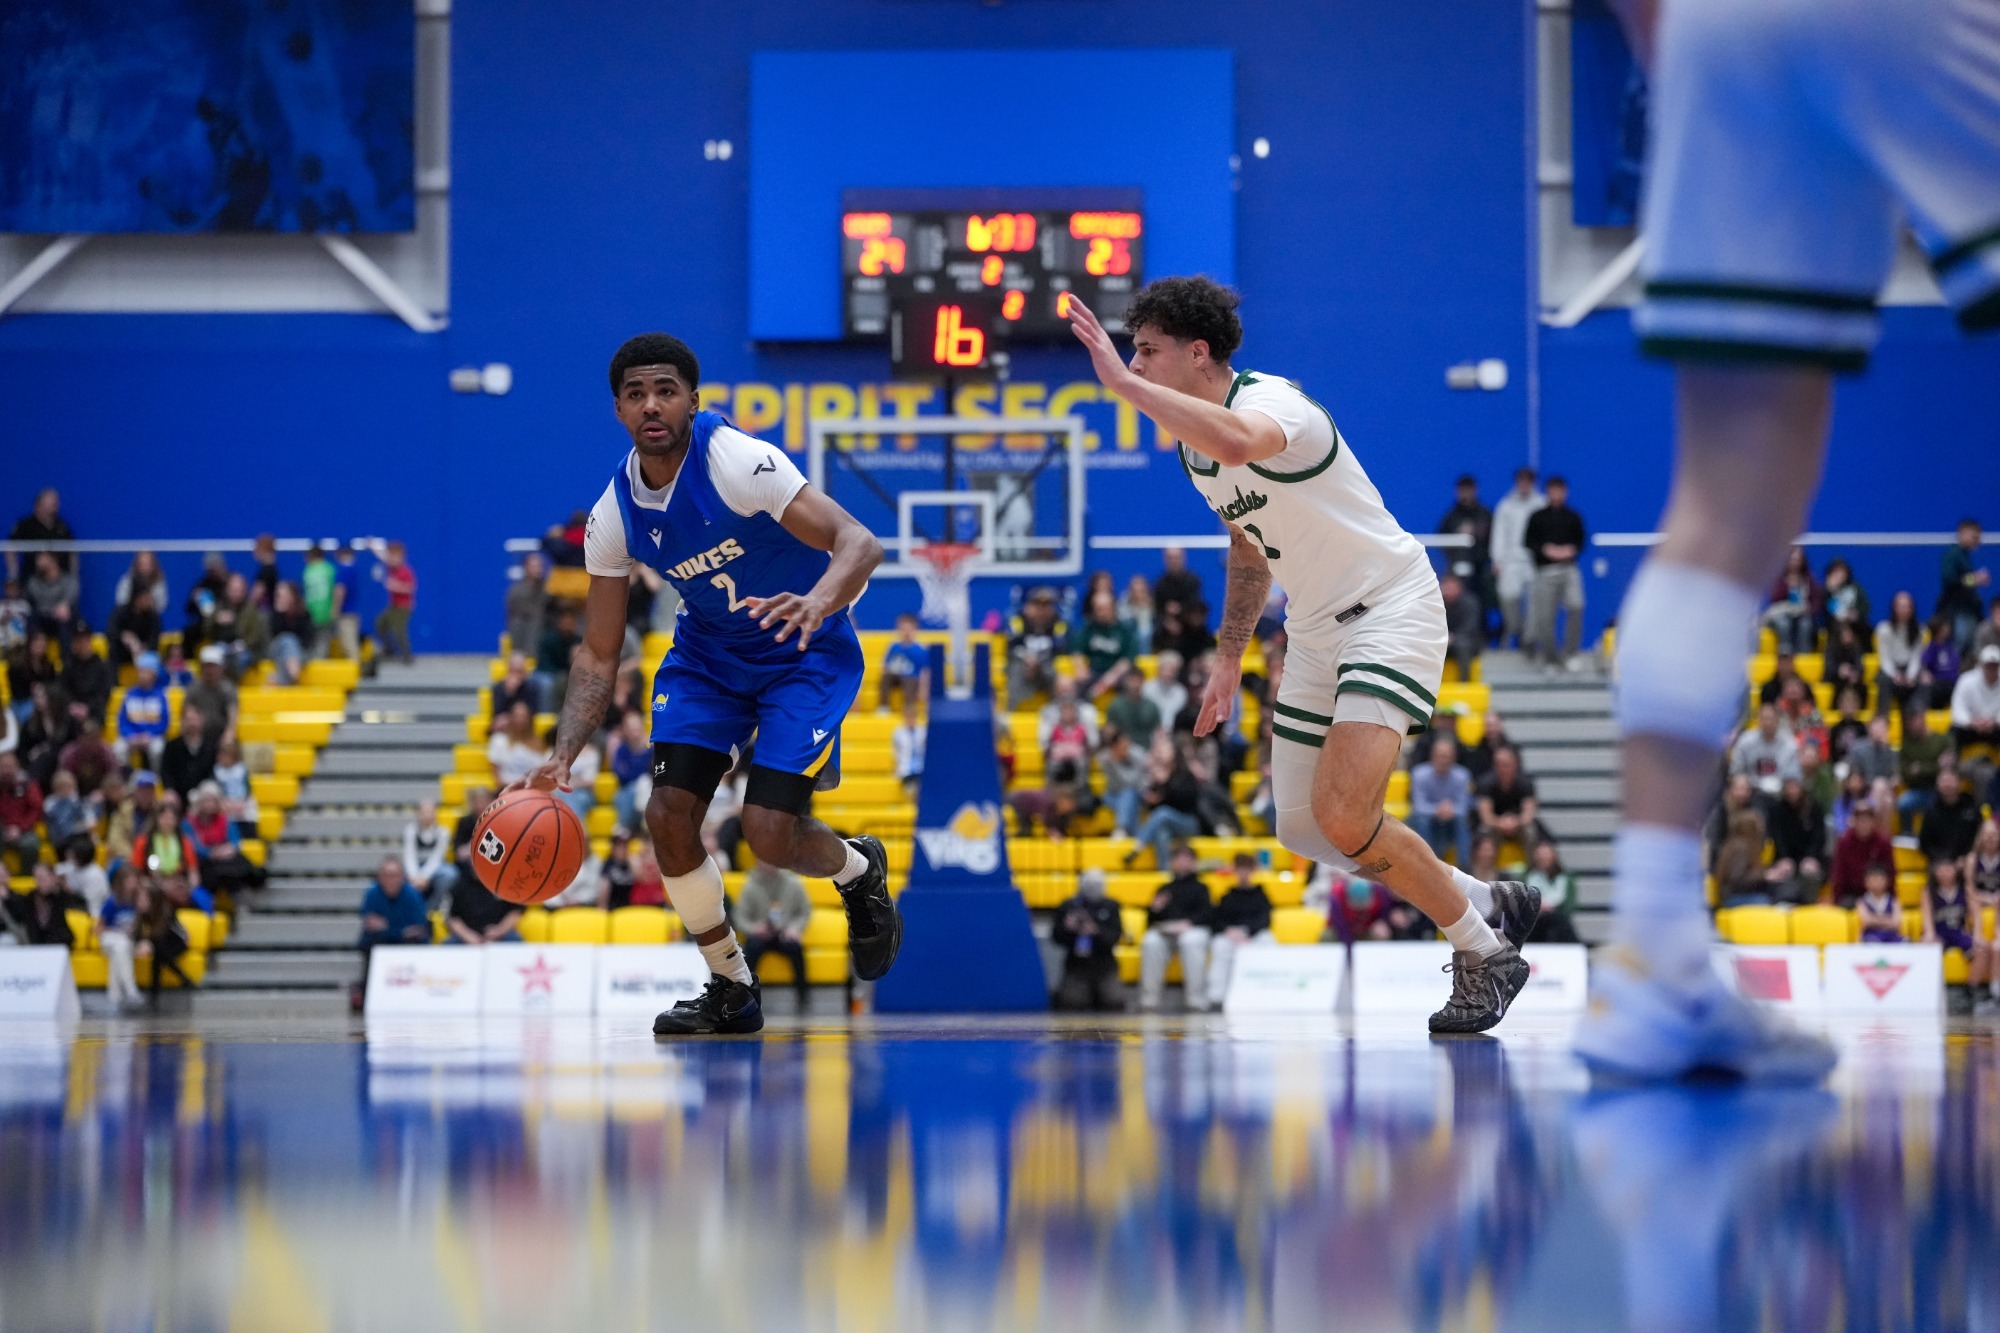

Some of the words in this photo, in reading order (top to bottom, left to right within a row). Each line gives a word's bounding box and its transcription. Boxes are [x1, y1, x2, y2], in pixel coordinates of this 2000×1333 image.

[934, 305, 984, 366] 16
[665, 538, 745, 581] VIKES
[710, 573, 747, 613] 2
[524, 834, 546, 869] MBB
